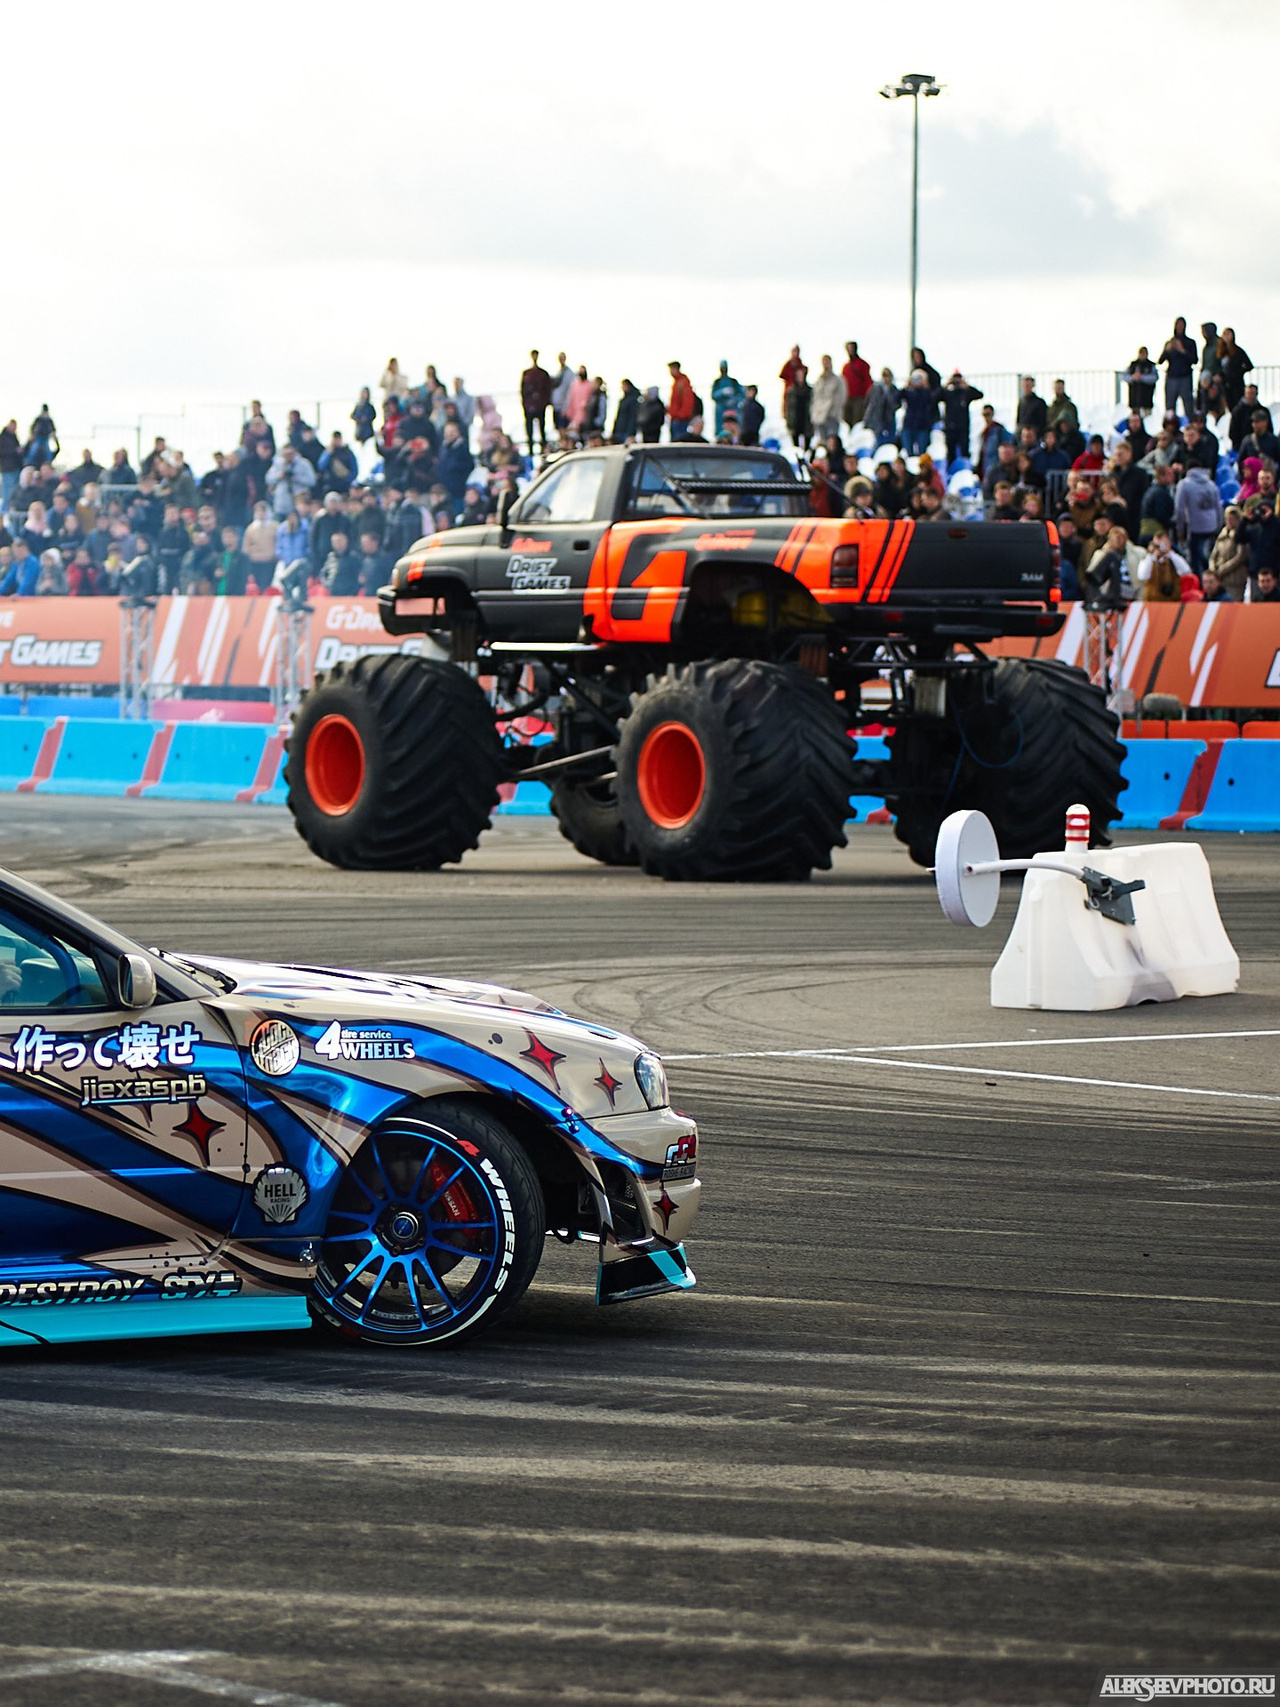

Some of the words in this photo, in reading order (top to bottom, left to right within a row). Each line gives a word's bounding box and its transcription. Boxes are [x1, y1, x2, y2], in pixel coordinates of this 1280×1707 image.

[508, 556, 557, 576] DRIFT
[512, 575, 569, 592] GAMES
[10, 634, 103, 667] GAMES
[359, 1029, 392, 1039] service
[13, 1023, 200, 1073] 作って壊せ
[341, 1042, 416, 1060] WHEELS
[264, 1183, 296, 1198] HELL
[479, 1158, 515, 1292] WHEELS
